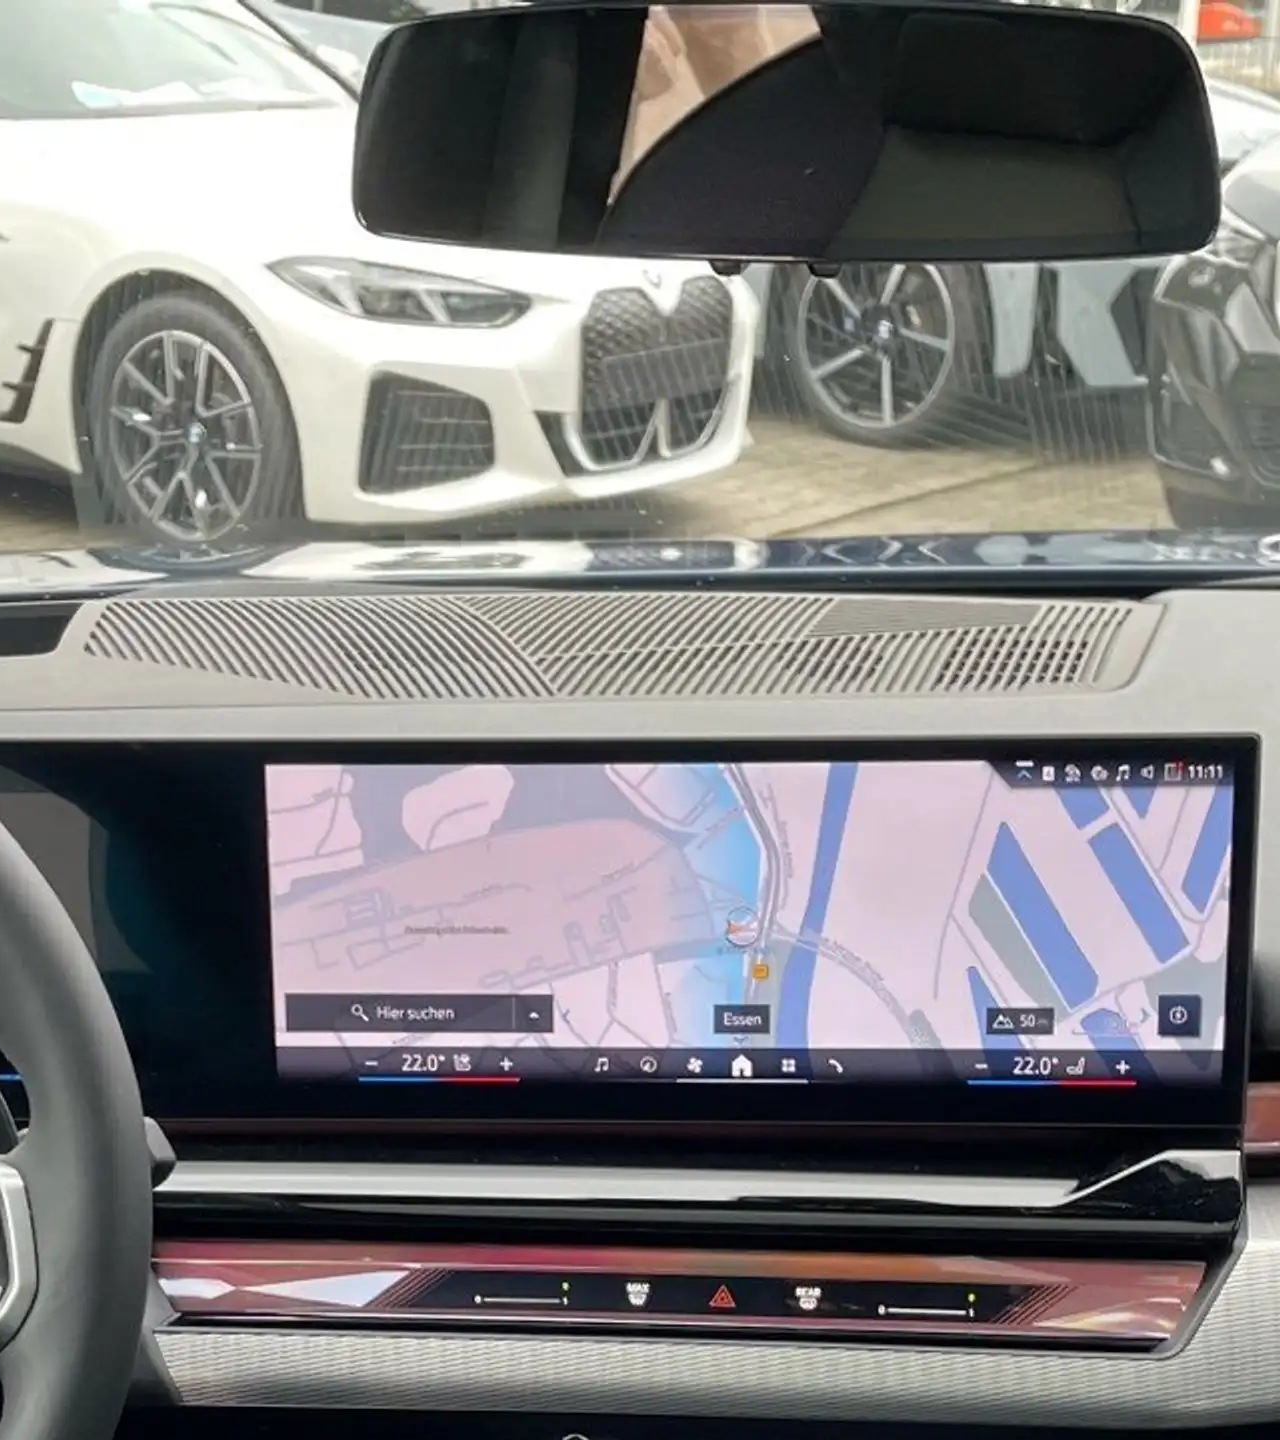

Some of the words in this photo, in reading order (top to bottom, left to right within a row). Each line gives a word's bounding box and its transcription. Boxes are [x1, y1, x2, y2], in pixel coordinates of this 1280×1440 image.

[1188, 765, 1224, 779] 11:11
[376, 1005, 406, 1021] Hier
[408, 1005, 455, 1022] suchen
[723, 1011, 763, 1027] Essen
[1019, 1015, 1035, 1029] 50
